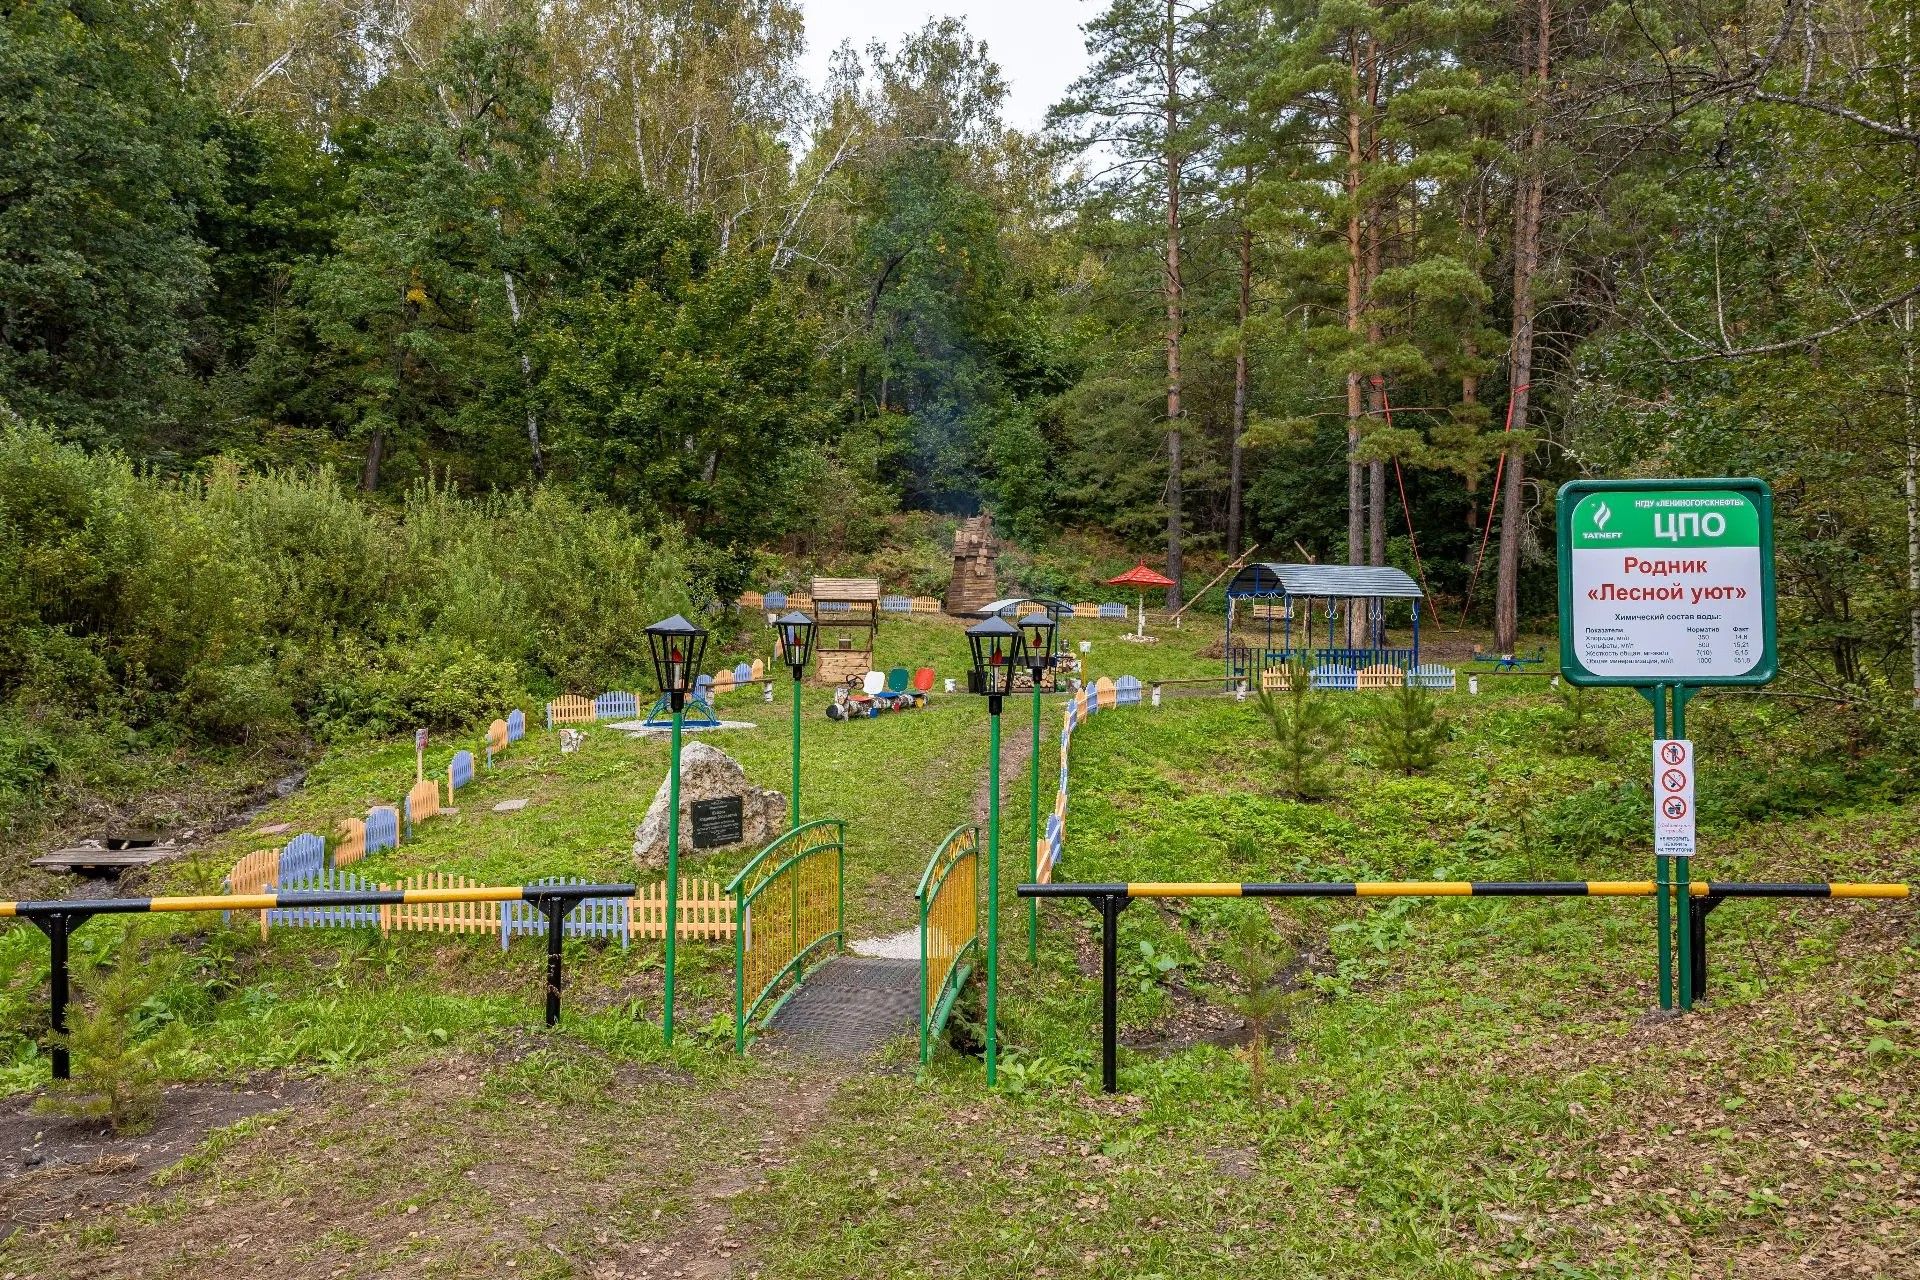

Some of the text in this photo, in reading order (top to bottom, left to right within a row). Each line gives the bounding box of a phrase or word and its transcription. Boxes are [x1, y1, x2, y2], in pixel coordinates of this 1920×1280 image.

[1635, 499, 1744, 508] НГДУ «ЛЕНИНОГОРСКНЕФТЬ»
[1654, 512, 1726, 542] ЦПО
[1624, 556, 1708, 577] Родник
[1587, 582, 1747, 604] «Лесной уют»
[1614, 613, 1665, 621] Химический
